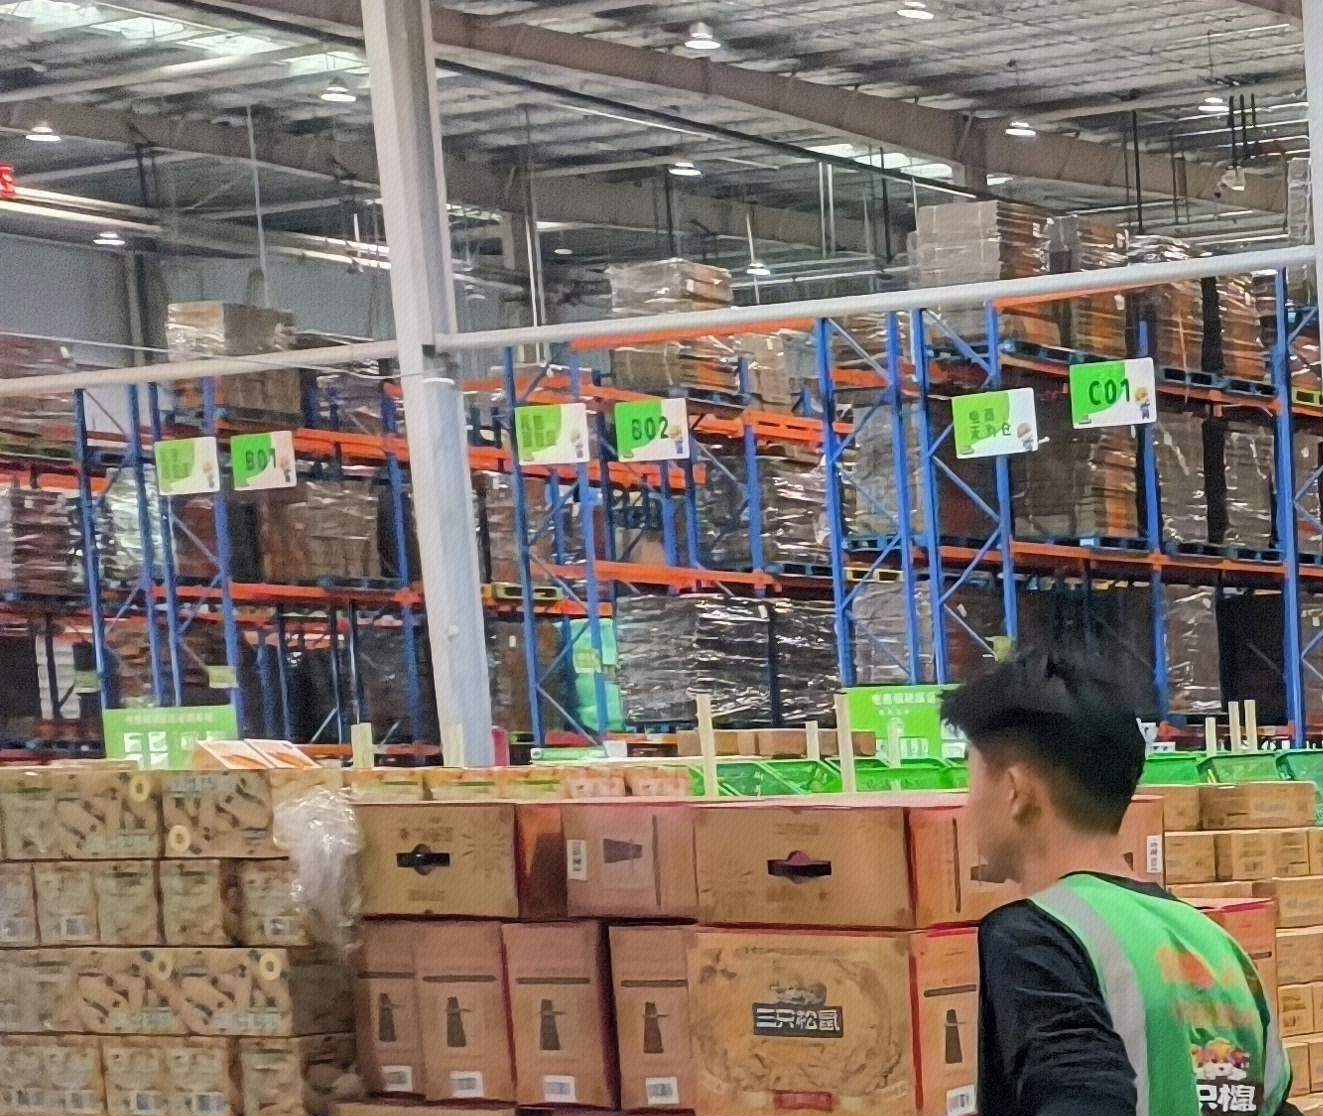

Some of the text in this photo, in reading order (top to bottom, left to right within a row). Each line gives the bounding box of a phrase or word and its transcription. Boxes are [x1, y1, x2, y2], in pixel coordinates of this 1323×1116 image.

[1088, 377, 1131, 406] C01
[631, 416, 669, 441] B02
[245, 447, 277, 471] B01
[756, 1008, 841, 1031] 三只松鼠
